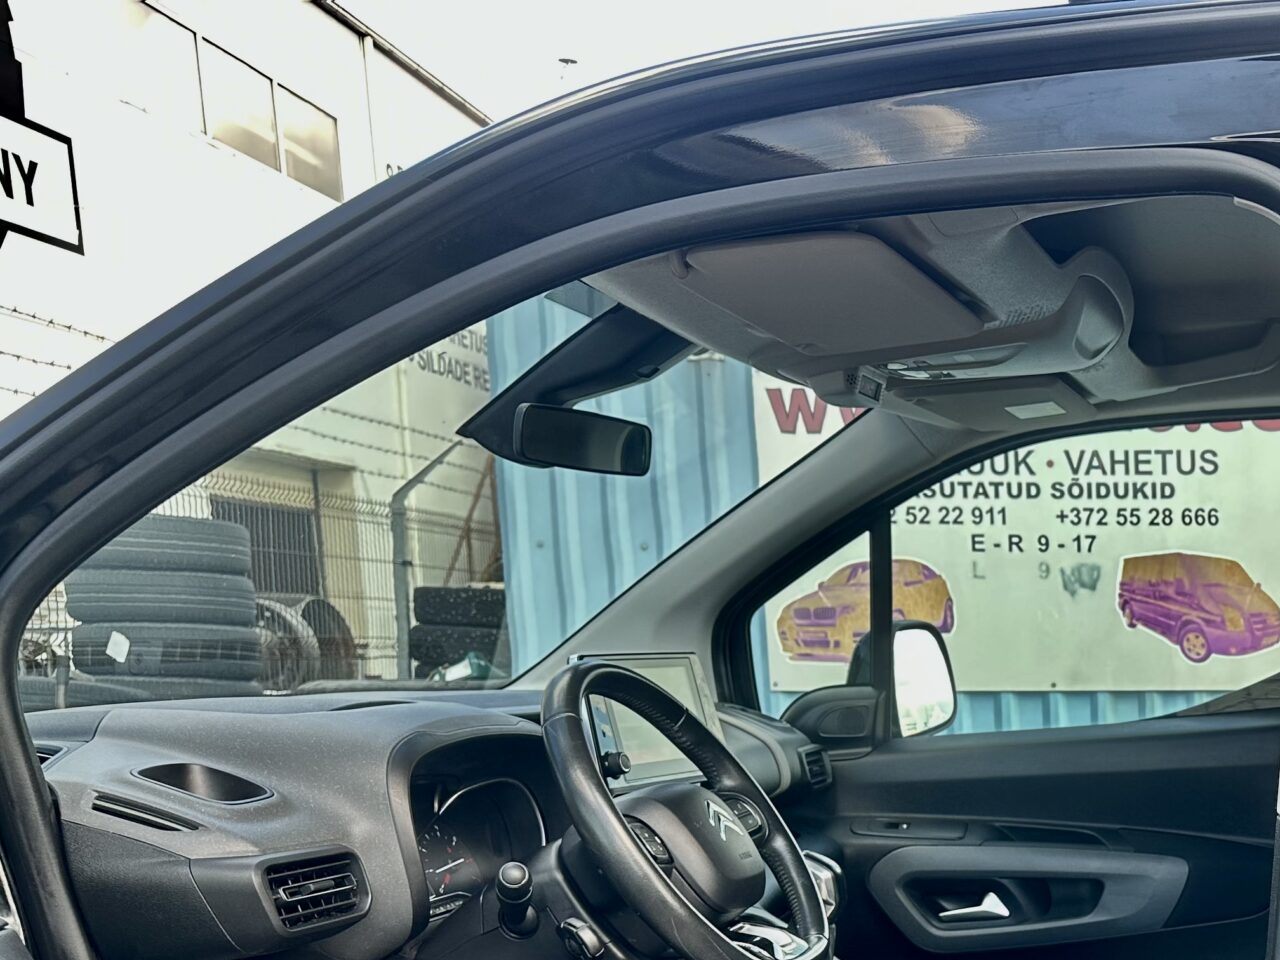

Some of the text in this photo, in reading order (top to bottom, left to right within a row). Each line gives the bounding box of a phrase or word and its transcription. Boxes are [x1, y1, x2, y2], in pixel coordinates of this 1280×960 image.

[1063, 449, 1219, 476] VAHETUS
[917, 478, 1176, 500] SUTATUD SÕIDUKID
[905, 506, 931, 524] 52
[938, 506, 964, 525] 22
[971, 506, 1007, 525] 911
[1056, 507, 1219, 526] +372 55 28 666
[971, 534, 986, 552] E
[1008, 534, 1024, 552] R
[1037, 534, 1050, 553] 9
[1072, 534, 1097, 553] 17
